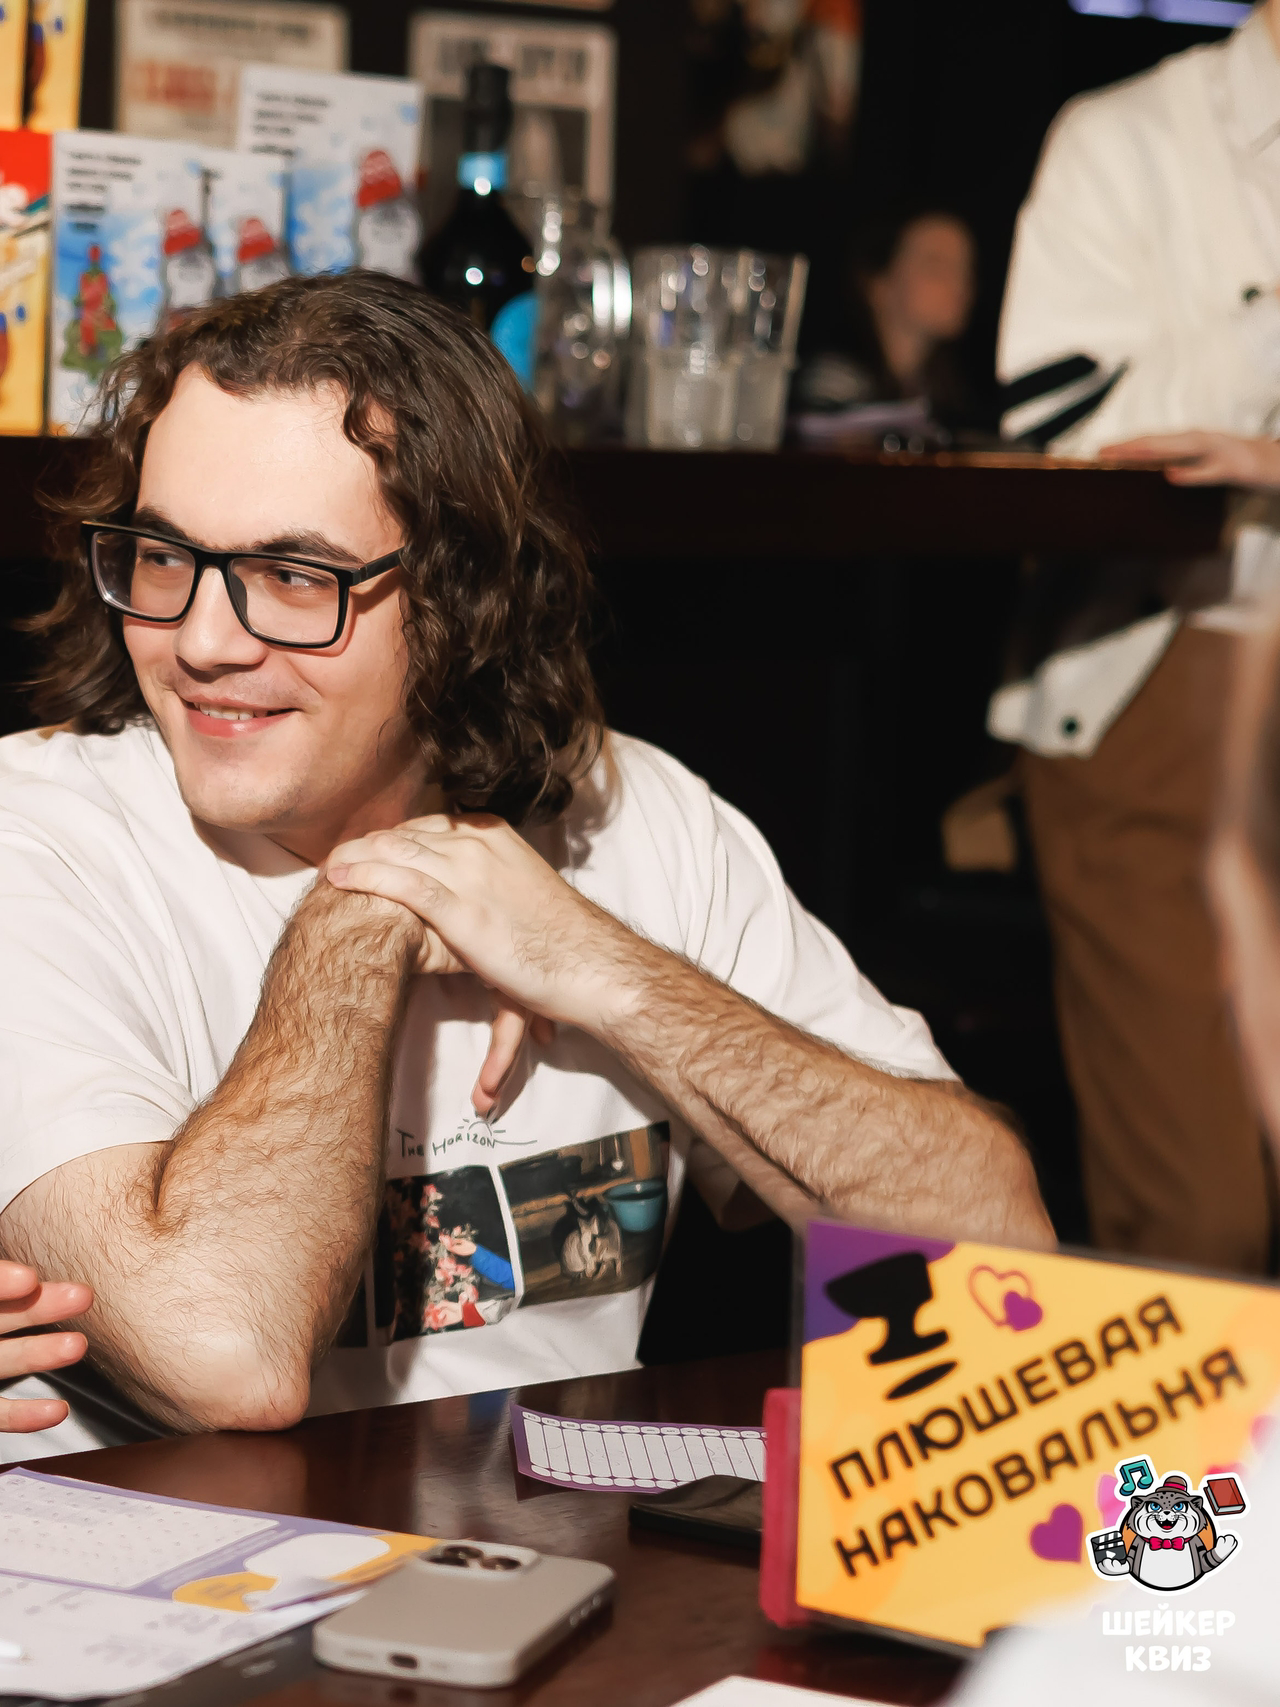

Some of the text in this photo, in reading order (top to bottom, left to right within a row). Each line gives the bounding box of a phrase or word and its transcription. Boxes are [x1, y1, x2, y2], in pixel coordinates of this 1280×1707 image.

[432, 1132, 496, 1156] HORIZON
[828, 1294, 1184, 1500] ПЛЮШЕВАЯ
[832, 1346, 1248, 1578] НАКОВАЛЬНЯ
